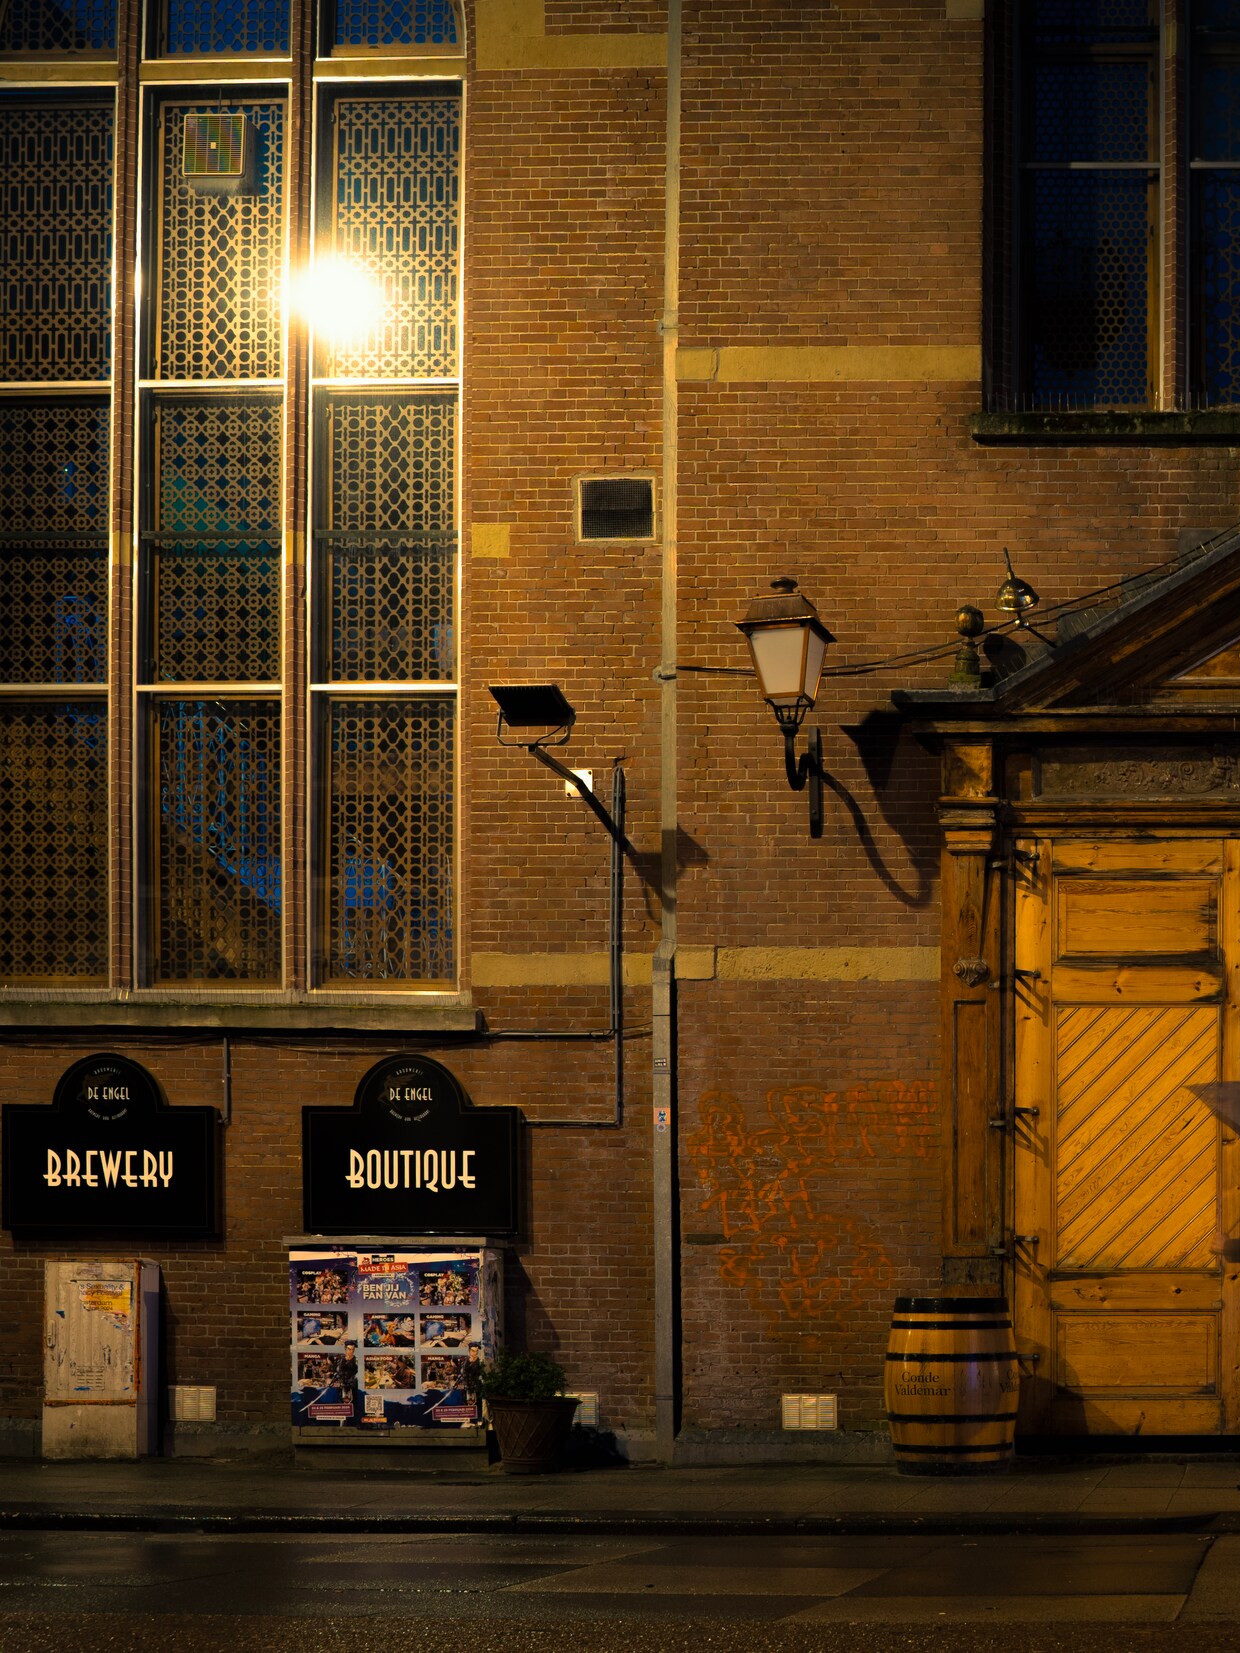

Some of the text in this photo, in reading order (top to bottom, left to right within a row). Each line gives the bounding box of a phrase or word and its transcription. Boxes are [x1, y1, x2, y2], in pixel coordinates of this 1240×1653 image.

[87, 1086, 131, 1100] DE ENGEL
[390, 1087, 433, 1101] DE ENGEL
[43, 1149, 174, 1188] BREWERY
[345, 1149, 476, 1193] BOUTIQUE
[363, 1284, 399, 1292] BEN JIJ
[902, 1371, 940, 1383] Conde
[895, 1384, 952, 1396] Valdemar
